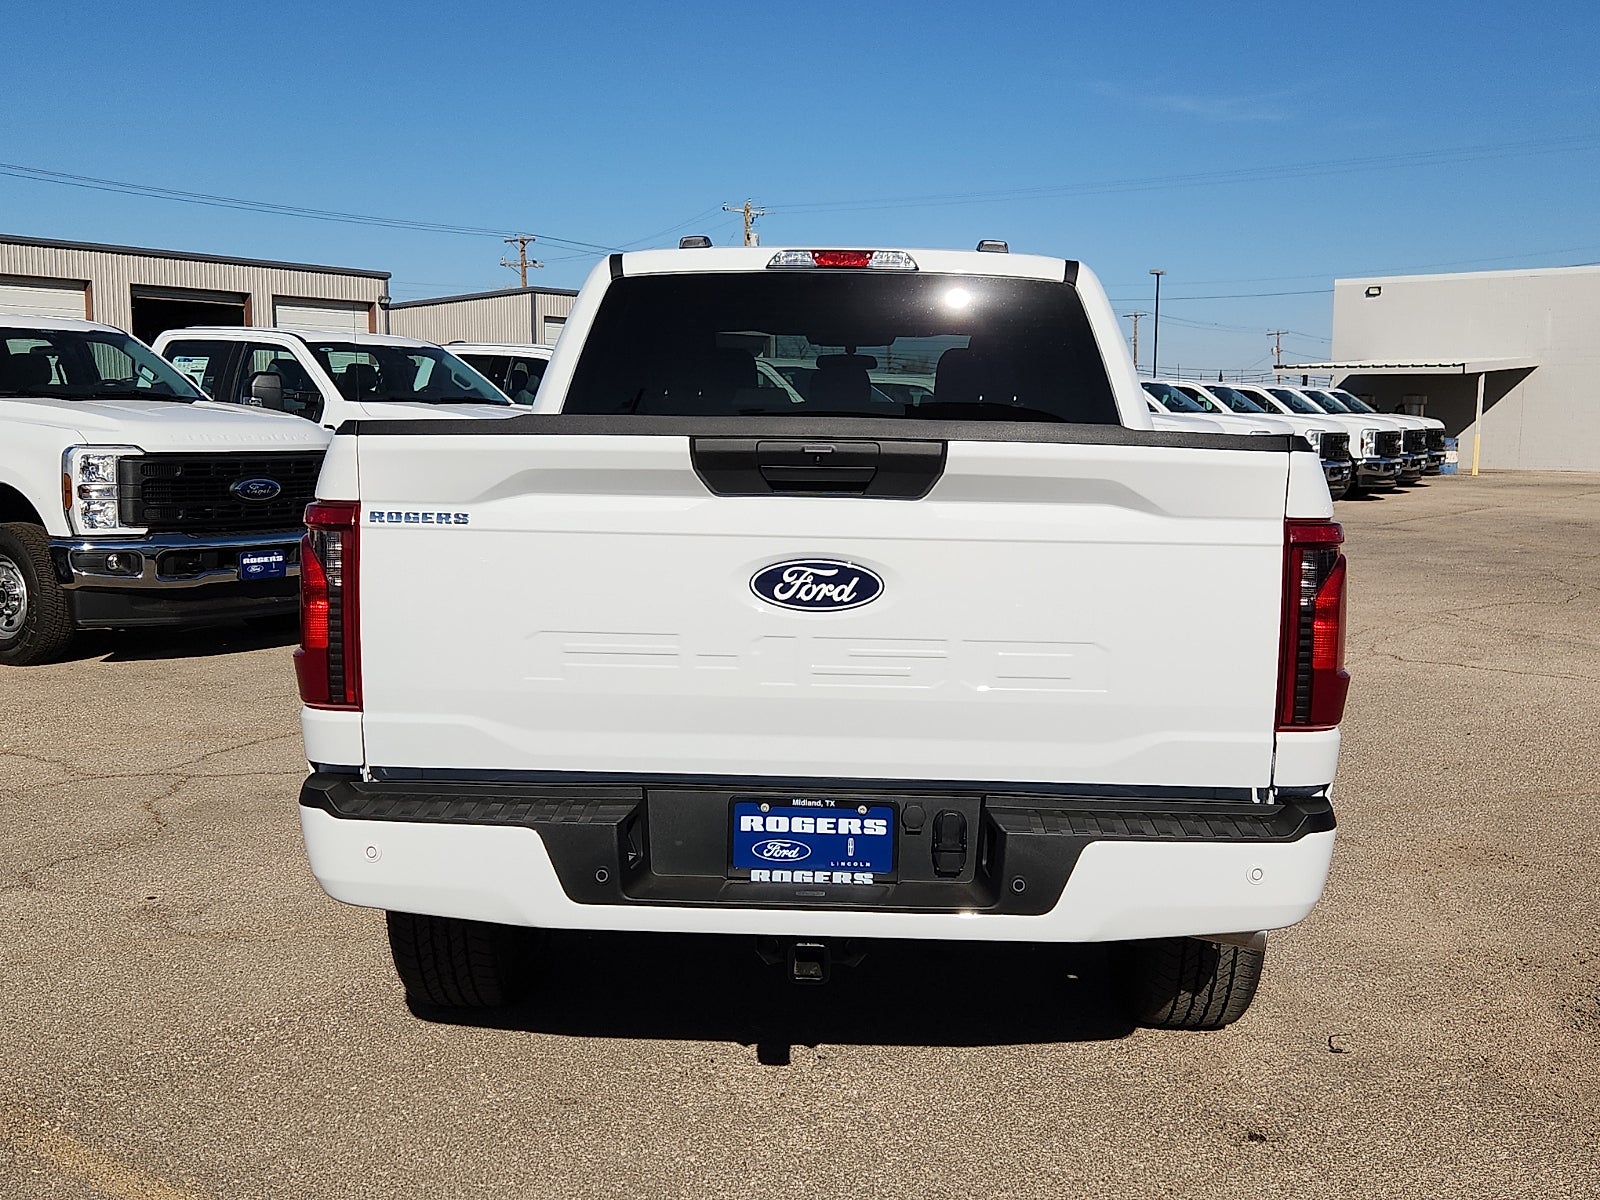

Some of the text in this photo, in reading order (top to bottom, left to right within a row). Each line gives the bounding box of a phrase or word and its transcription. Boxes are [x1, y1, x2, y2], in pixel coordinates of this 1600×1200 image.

[369, 511, 470, 525] ROGERS
[773, 566, 860, 602] Ford
[792, 798, 836, 808] Midland, TX
[740, 815, 888, 836] ROGERS
[762, 841, 800, 858] Ford
[750, 869, 875, 885] ROGERS
